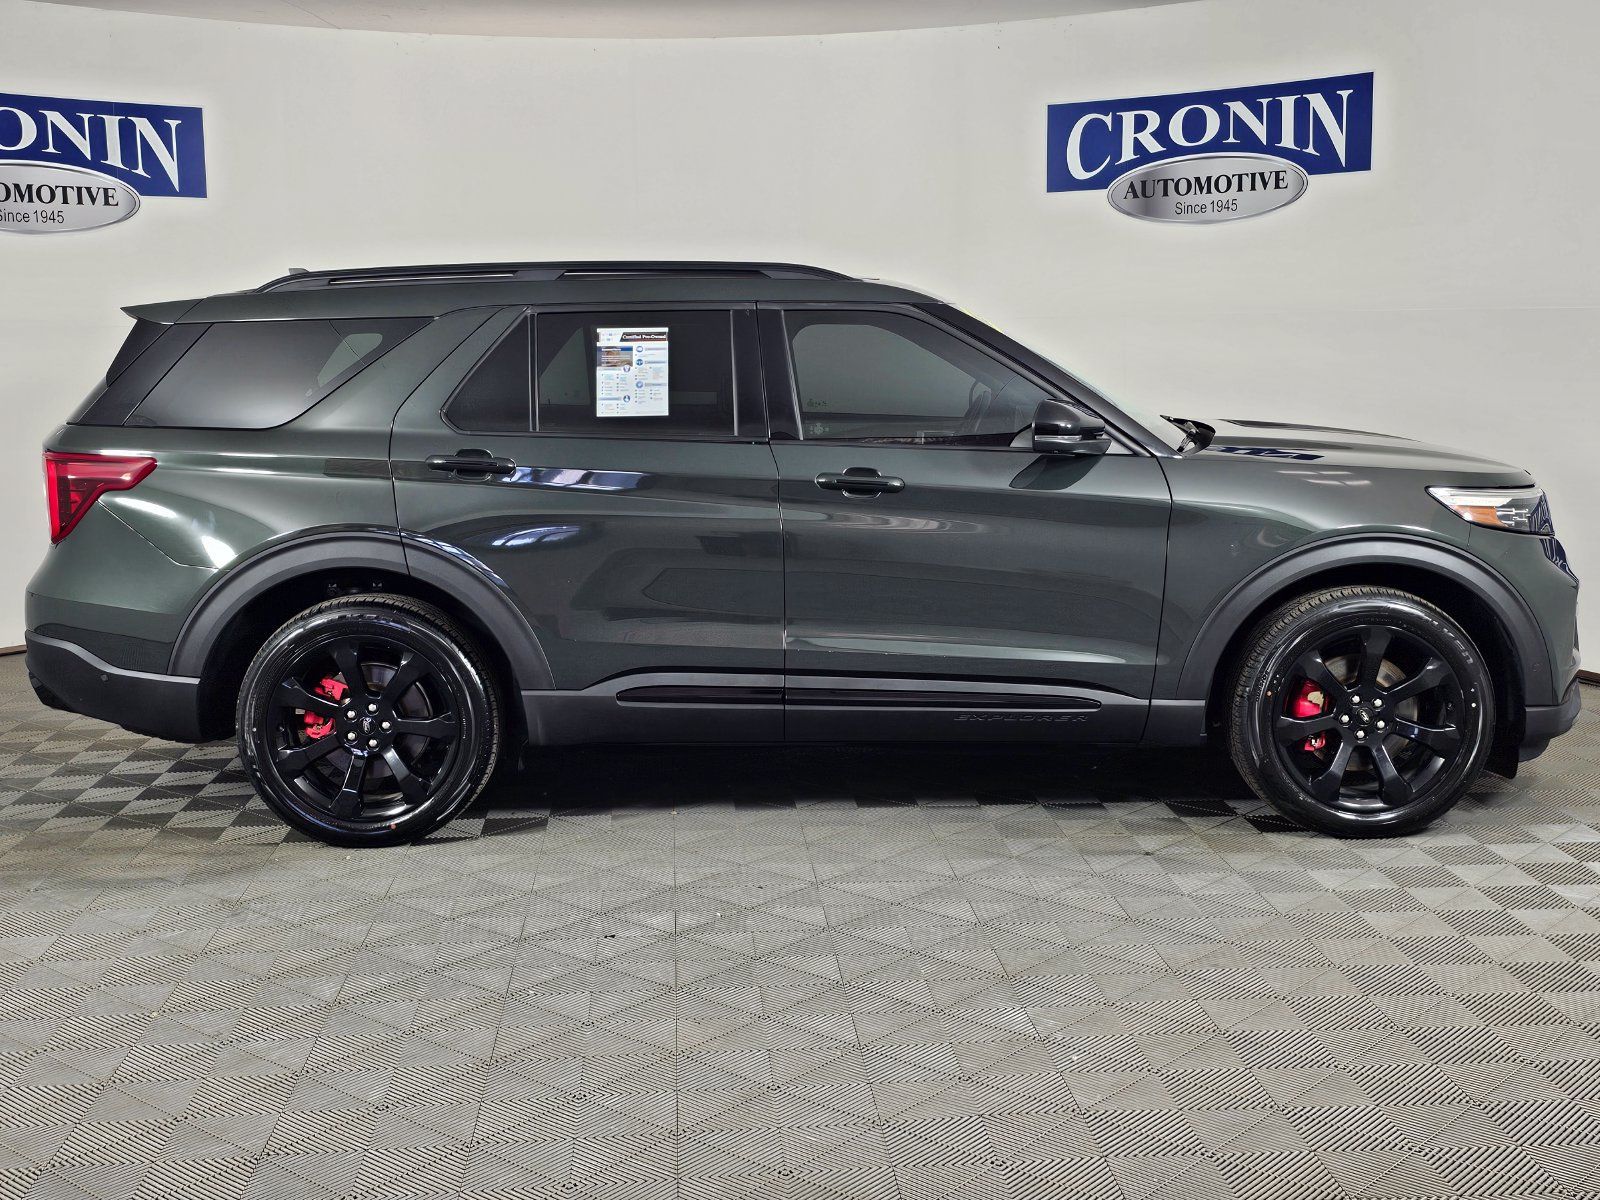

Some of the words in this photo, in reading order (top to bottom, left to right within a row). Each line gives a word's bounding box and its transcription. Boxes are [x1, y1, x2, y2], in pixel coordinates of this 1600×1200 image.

[1066, 89, 1353, 180] CRONIN
[1123, 170, 1289, 201] AUTOMOTIVE
[1174, 202, 1208, 215] Since
[1209, 199, 1239, 213] 1945
[33, 209, 65, 223] 1945
[953, 712, 1089, 722] EXPLORER
